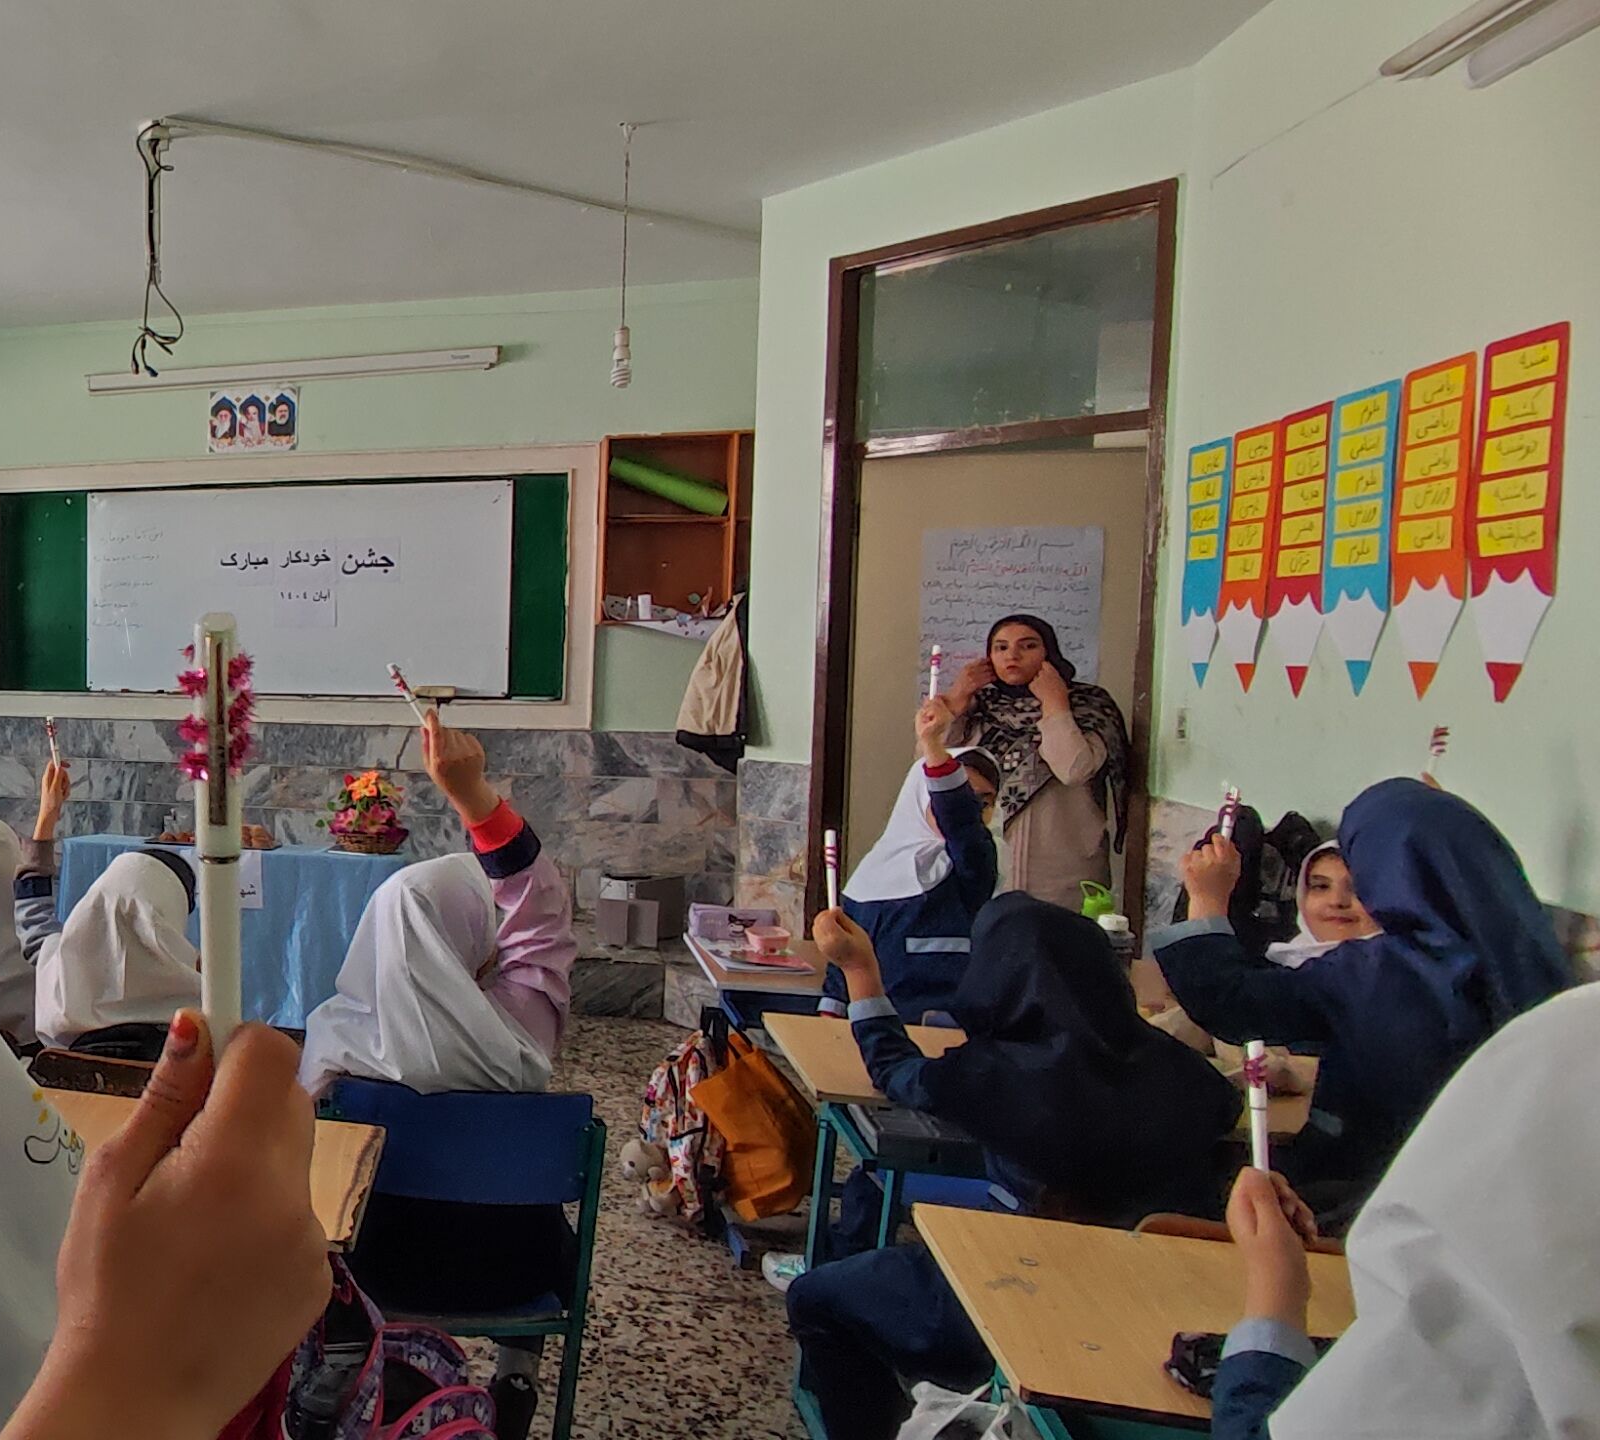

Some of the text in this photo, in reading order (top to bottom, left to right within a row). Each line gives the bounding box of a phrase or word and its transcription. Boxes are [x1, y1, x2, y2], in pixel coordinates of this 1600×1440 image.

[220, 548, 395, 575] جشن خودکار مبارک
